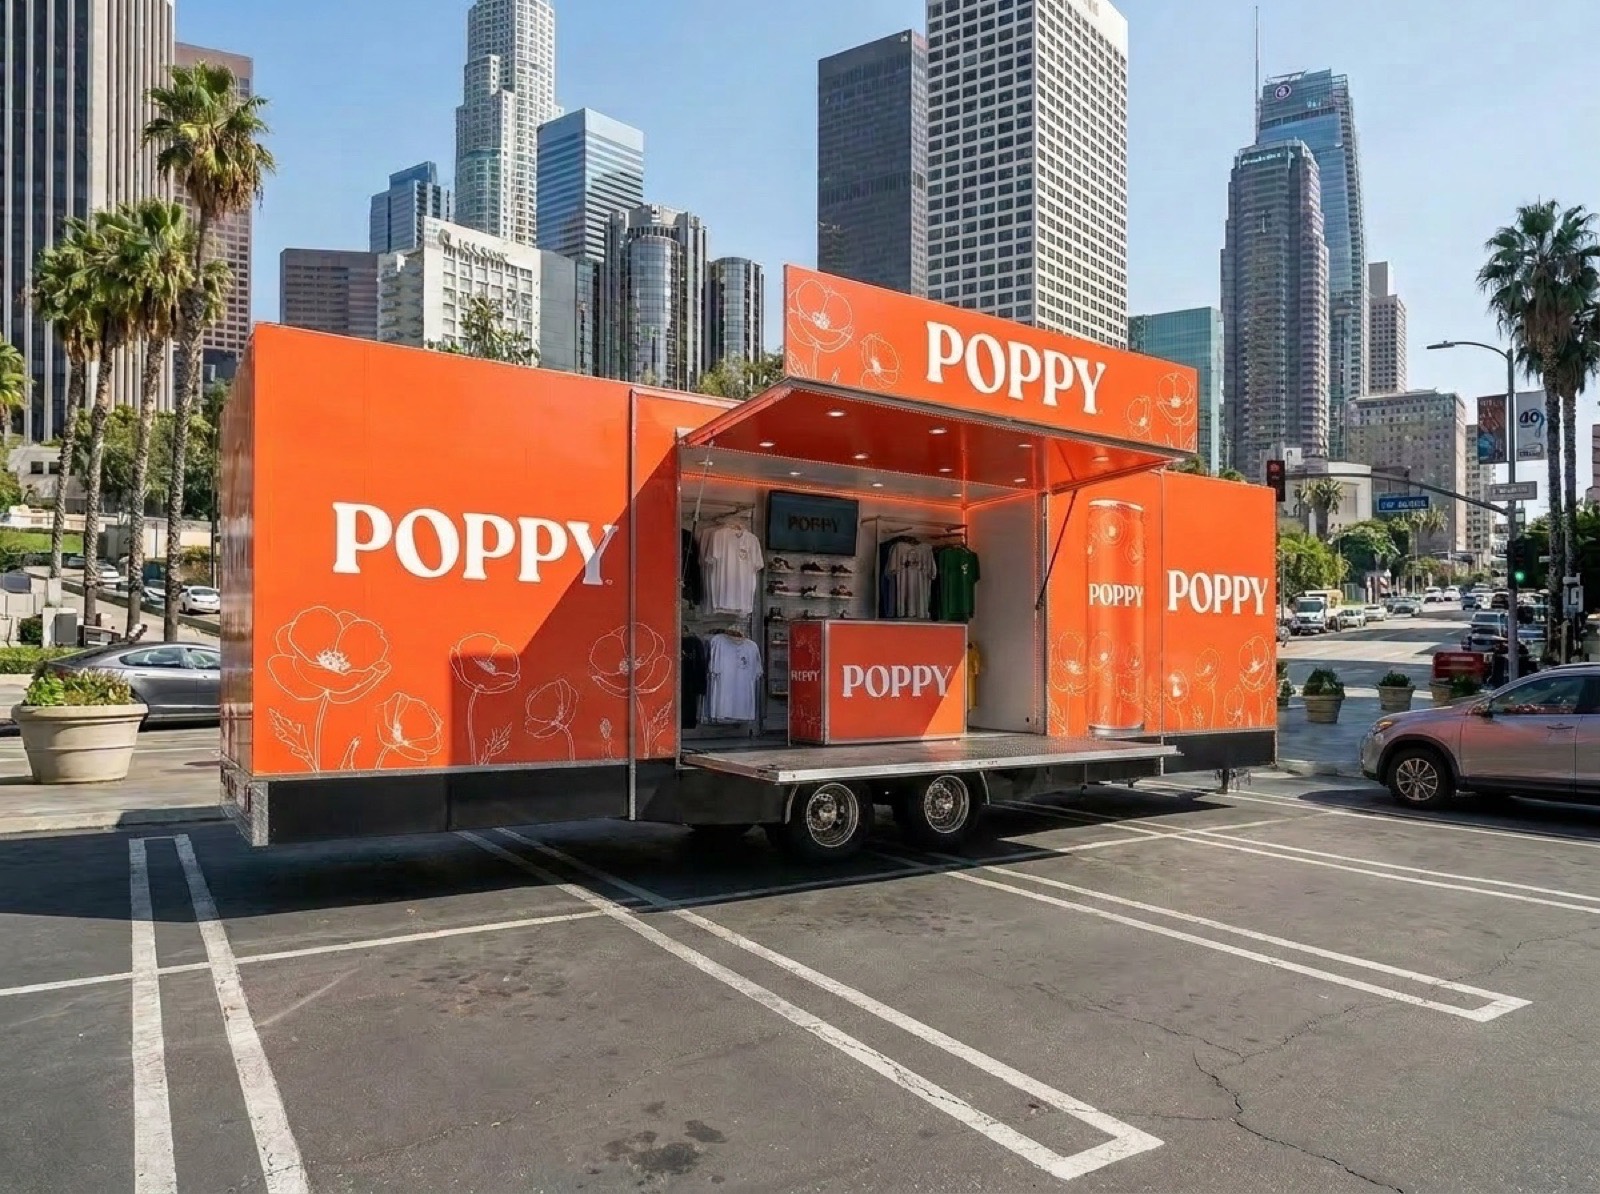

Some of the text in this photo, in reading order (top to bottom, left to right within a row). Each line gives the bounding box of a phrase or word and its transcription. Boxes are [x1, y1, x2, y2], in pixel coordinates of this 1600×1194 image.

[926, 321, 1107, 414] POPPY
[332, 502, 619, 585] POPPY
[1088, 583, 1144, 607] POPPY
[1167, 570, 1268, 615] POPPY
[842, 665, 952, 698] POPPY
